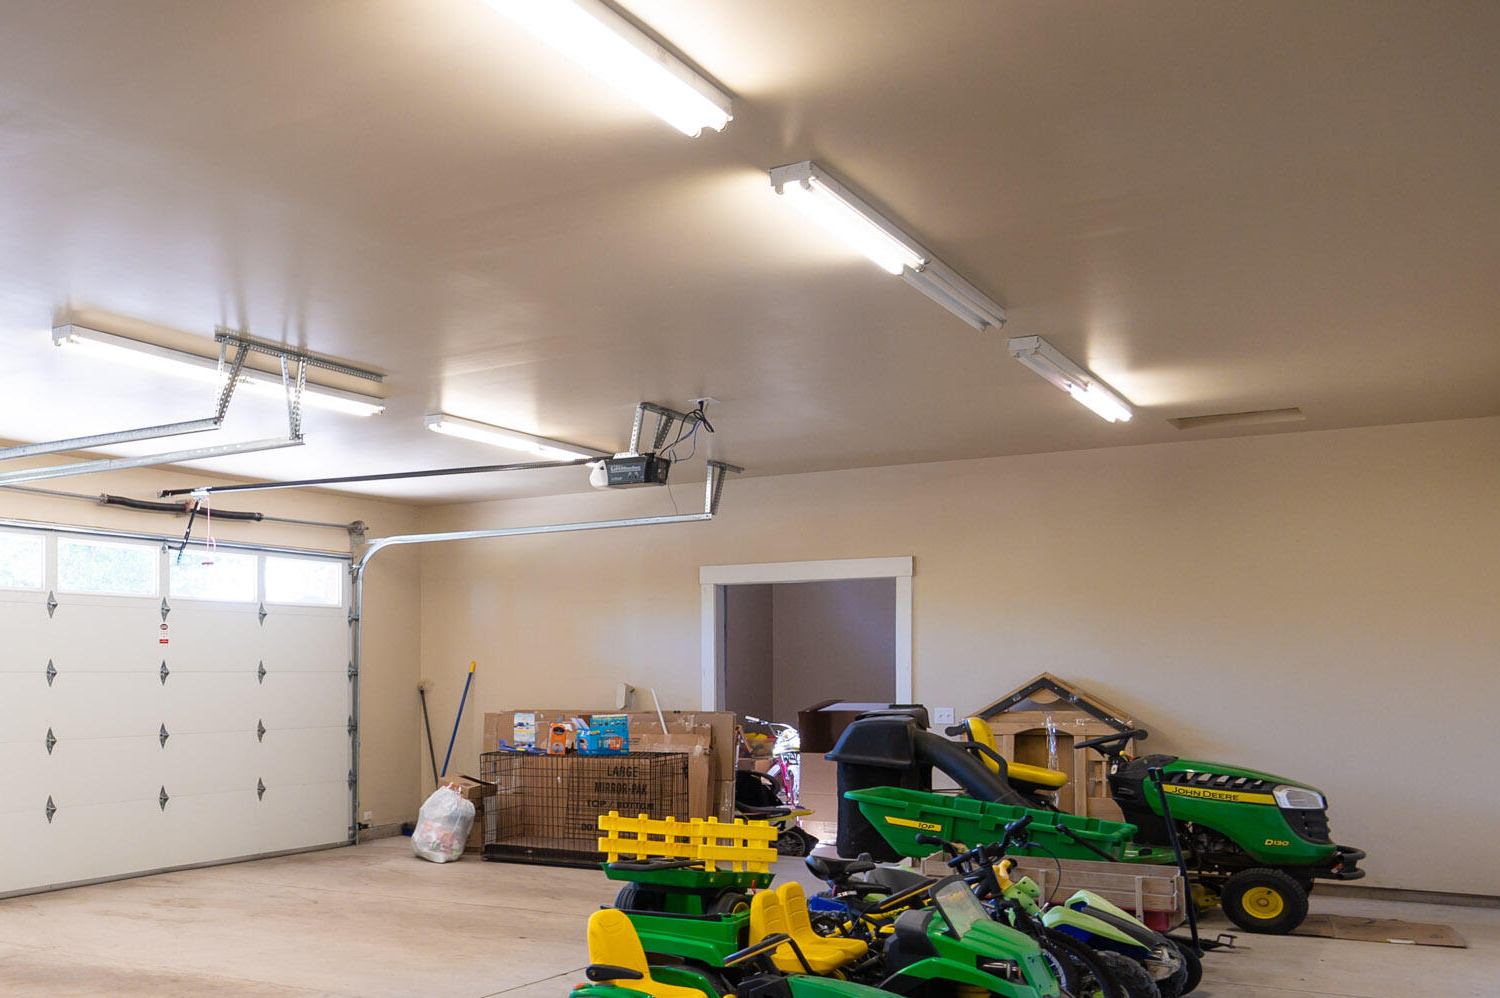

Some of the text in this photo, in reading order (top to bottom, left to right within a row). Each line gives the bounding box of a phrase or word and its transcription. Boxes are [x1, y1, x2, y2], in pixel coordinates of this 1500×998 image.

[607, 766, 638, 777] LARGE
[594, 782, 647, 795] MIRROR-PAK
[1172, 786, 1240, 801] JOHN DEERE
[586, 800, 607, 808] TOP
[616, 801, 655, 810] BOTTOM
[1264, 838, 1290, 847] D130
